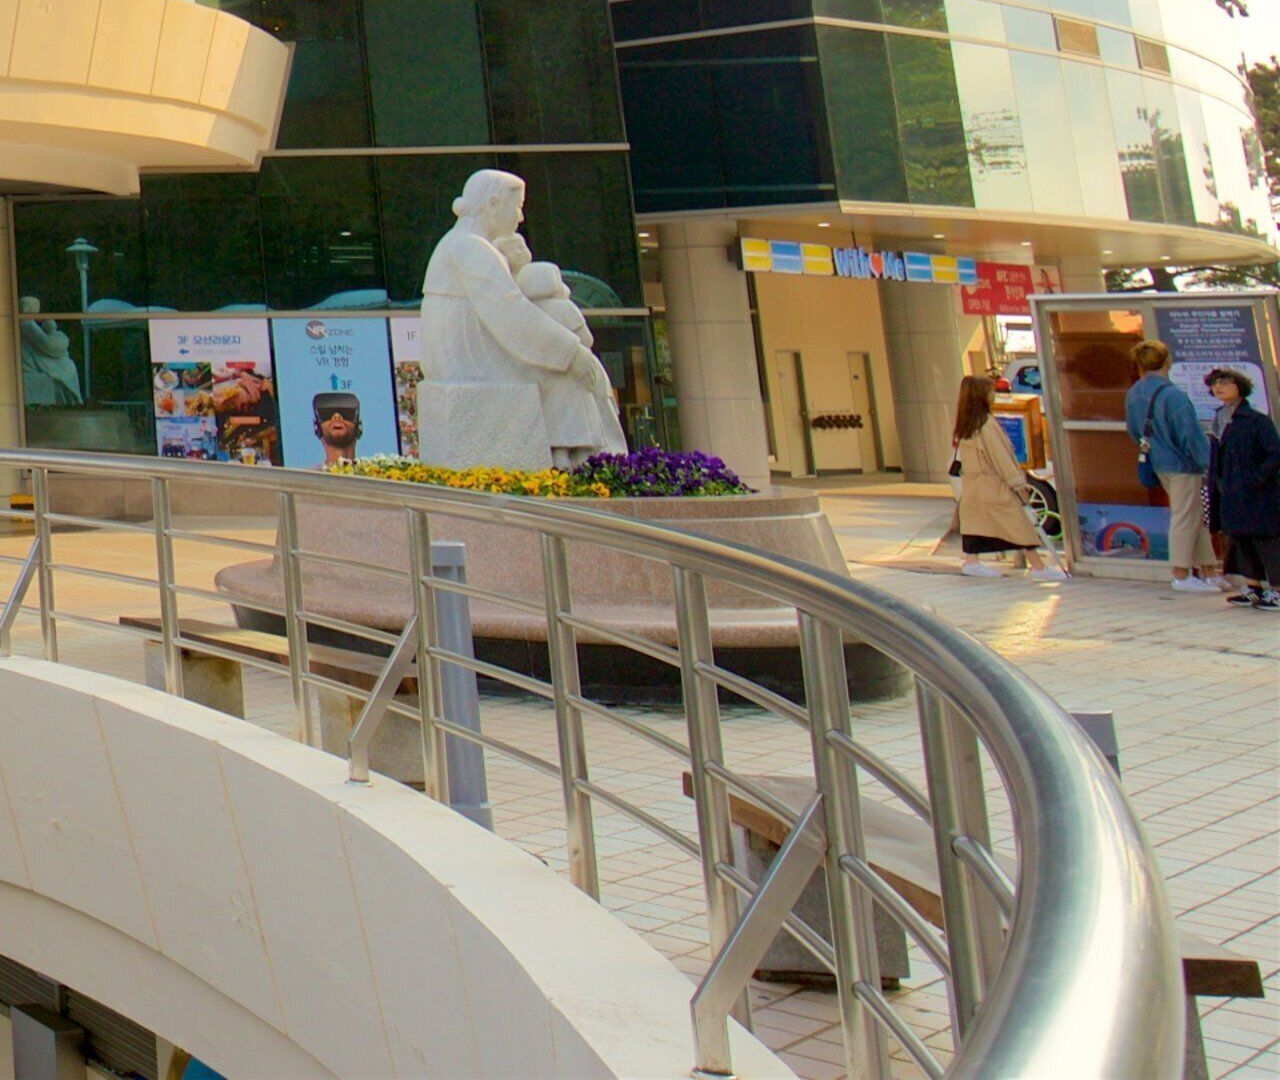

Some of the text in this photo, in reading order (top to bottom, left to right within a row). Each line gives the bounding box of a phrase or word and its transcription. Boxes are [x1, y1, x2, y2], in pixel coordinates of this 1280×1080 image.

[834, 247, 905, 281] With Me
[341, 380, 352, 390] 3F
